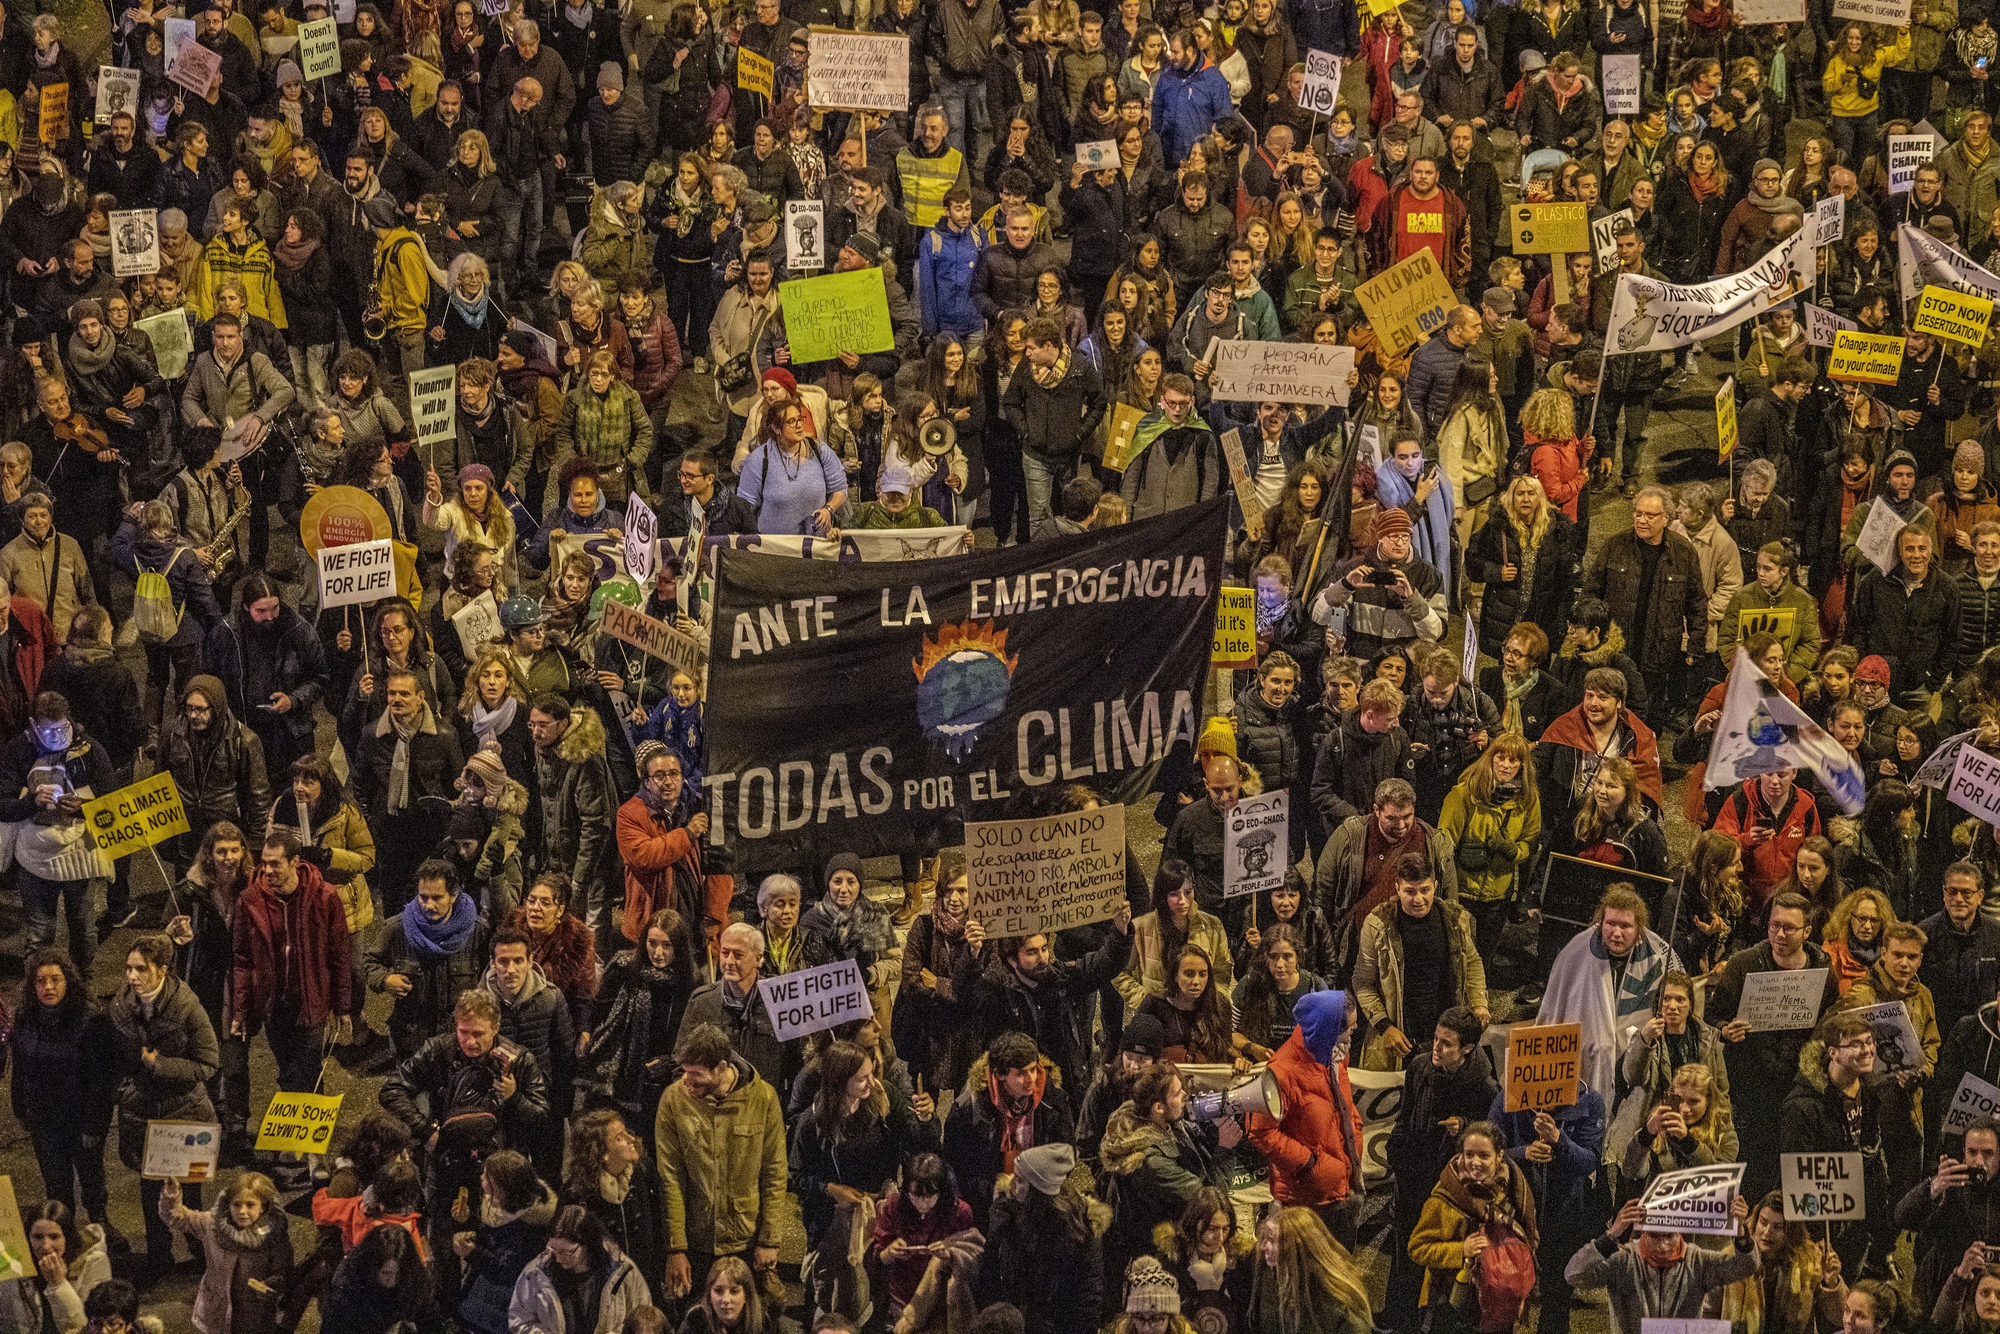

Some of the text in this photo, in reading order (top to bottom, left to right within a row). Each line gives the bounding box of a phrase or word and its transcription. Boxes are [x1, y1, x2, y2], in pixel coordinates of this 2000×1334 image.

[1875, 6, 1906, 18] LUCHANDO!
[304, 23, 332, 40] Doesn't
[302, 41, 337, 58] my future
[826, 52, 842, 65] NO
[844, 52, 855, 65] EL
[309, 56, 334, 73] count?
[739, 71, 761, 84] no your
[1625, 86, 1637, 95] and
[1891, 141, 1932, 153] CLIMATE
[1406, 212, 1443, 226] BAH!
[1363, 255, 1432, 305] YA LO DIJO
[1923, 296, 1988, 325] STOP NOW
[1390, 305, 1446, 349] EN 1800
[1918, 313, 1983, 343] DESERTIZATION!
[1838, 335, 1868, 354] Change
[1868, 342, 1887, 355] your
[1888, 341, 1902, 358] life,
[1833, 358, 1898, 376] no your climate.
[414, 377, 453, 397] Tomorrow
[1219, 380, 1236, 393] LA
[421, 398, 447, 416] will be
[419, 416, 450, 437] too late!
[325, 527, 367, 537] ENERGÍA
[327, 515, 366, 529] 100%
[323, 546, 391, 572] WE FIGTH
[325, 570, 391, 596] FOR LIFE!
[731, 555, 1208, 658] ANTE LA EMERGENCIA
[1229, 594, 1253, 609] wait
[1229, 615, 1246, 630] it's
[603, 602, 696, 671] PACHAMAMA
[1225, 638, 1253, 653] late.
[702, 690, 1196, 847] TODAS POR EL CLIMA
[1962, 753, 1988, 778] WE
[1954, 777, 1985, 804] FOR
[118, 786, 172, 818] CLIMATE
[97, 806, 184, 849] CHAOS, NOW!
[973, 815, 1105, 848] SOLO CUANDO
[972, 838, 1102, 870] desaparezca EL
[975, 851, 1123, 887] ÚLTIMO RÍO, ÁRBOL Y
[973, 870, 1125, 906] ANIMAL, entenderemos
[973, 909, 1006, 926] que
[1007, 905, 1022, 915] no
[1052, 891, 1097, 912] podemos
[1006, 918, 1029, 933] EL
[1039, 904, 1094, 931] DINERO
[769, 967, 856, 1004] WE FIGTH
[777, 991, 862, 1029] FOR LIFE!
[1780, 994, 1807, 1005] NEMO
[1791, 1012, 1813, 1021] DEAD
[1516, 1033, 1578, 1057] THE RICH
[1513, 1061, 1575, 1083] POLLUTE
[1520, 1088, 1563, 1108] A LOT.
[268, 1102, 300, 1118] NOW!
[263, 1122, 309, 1140] CLIMATE
[1796, 1156, 1850, 1180] HEAL
[1654, 1175, 1730, 1200] STOP
[1815, 1181, 1834, 1191] THE
[1789, 1193, 1856, 1218] WORLD
[1645, 1215, 1728, 1230] cambiemos la ley
